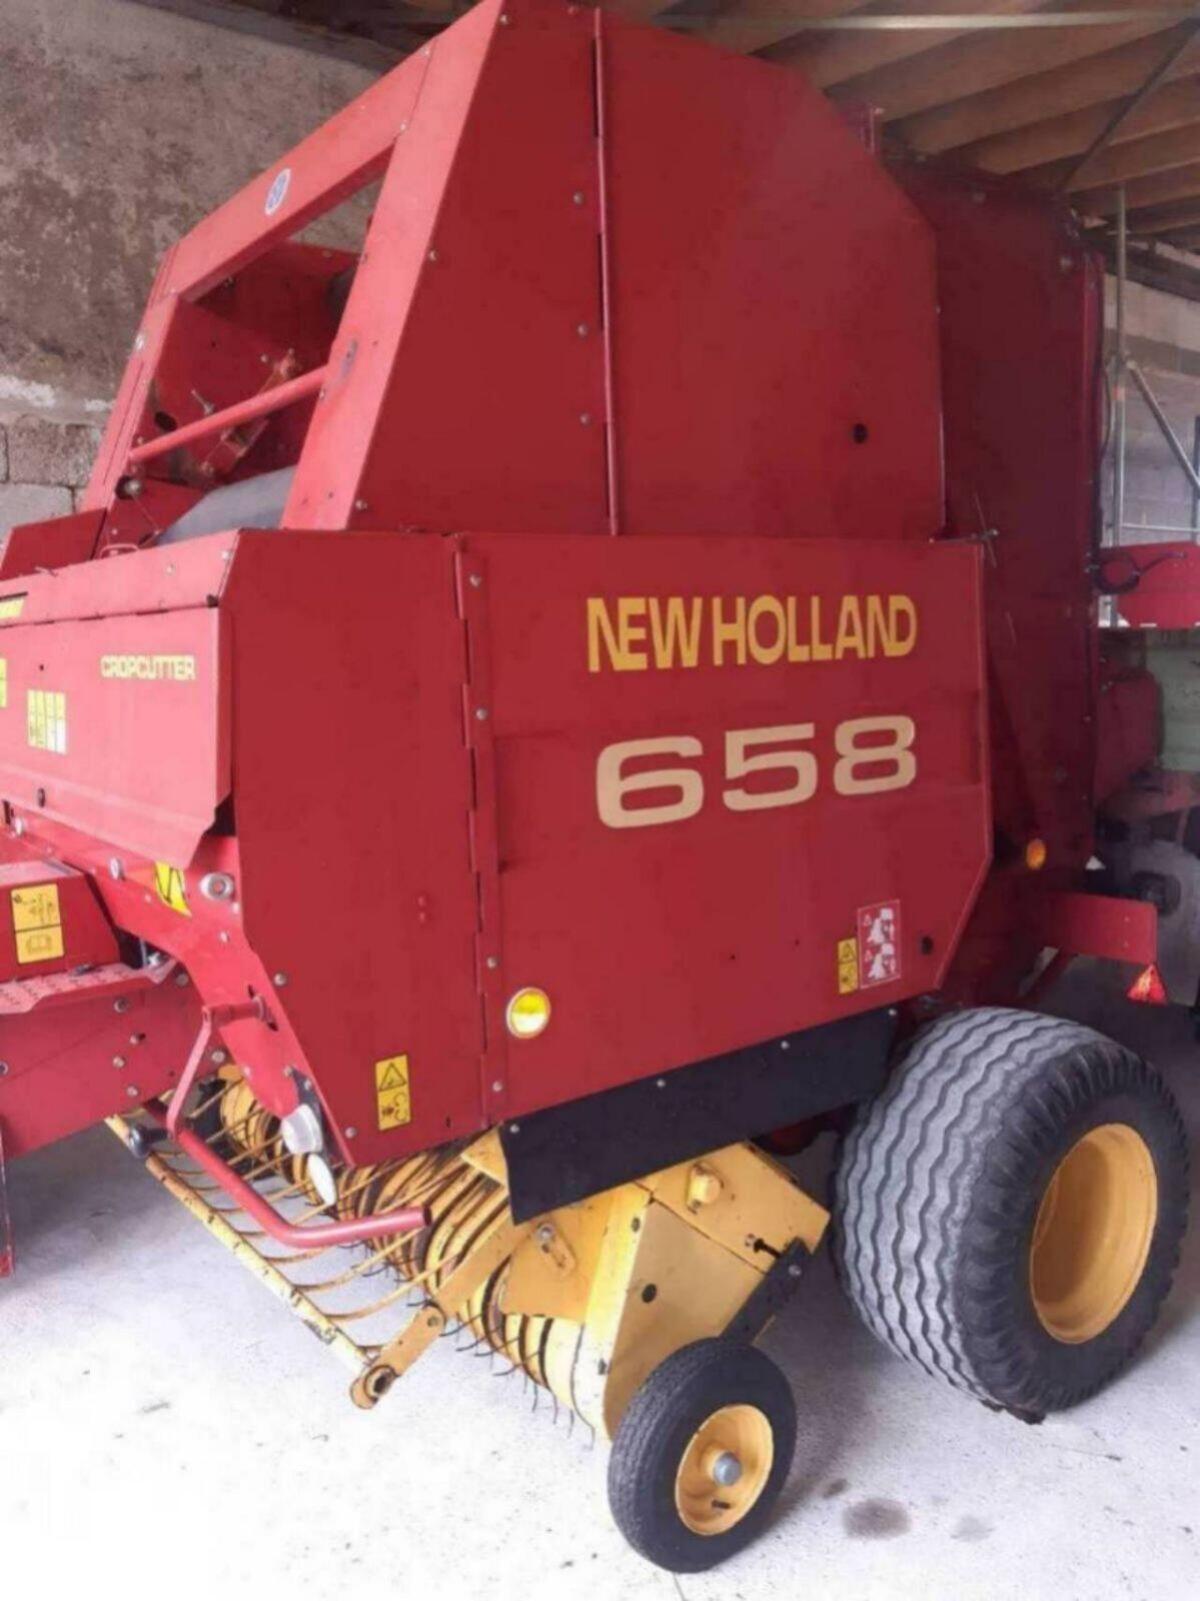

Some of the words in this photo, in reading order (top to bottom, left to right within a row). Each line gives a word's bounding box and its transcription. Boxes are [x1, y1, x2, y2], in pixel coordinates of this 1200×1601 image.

[100, 655, 195, 680] CROPCUTTER
[587, 597, 702, 672] NEW
[712, 594, 917, 666] HOLLAND
[596, 715, 917, 829] 658
